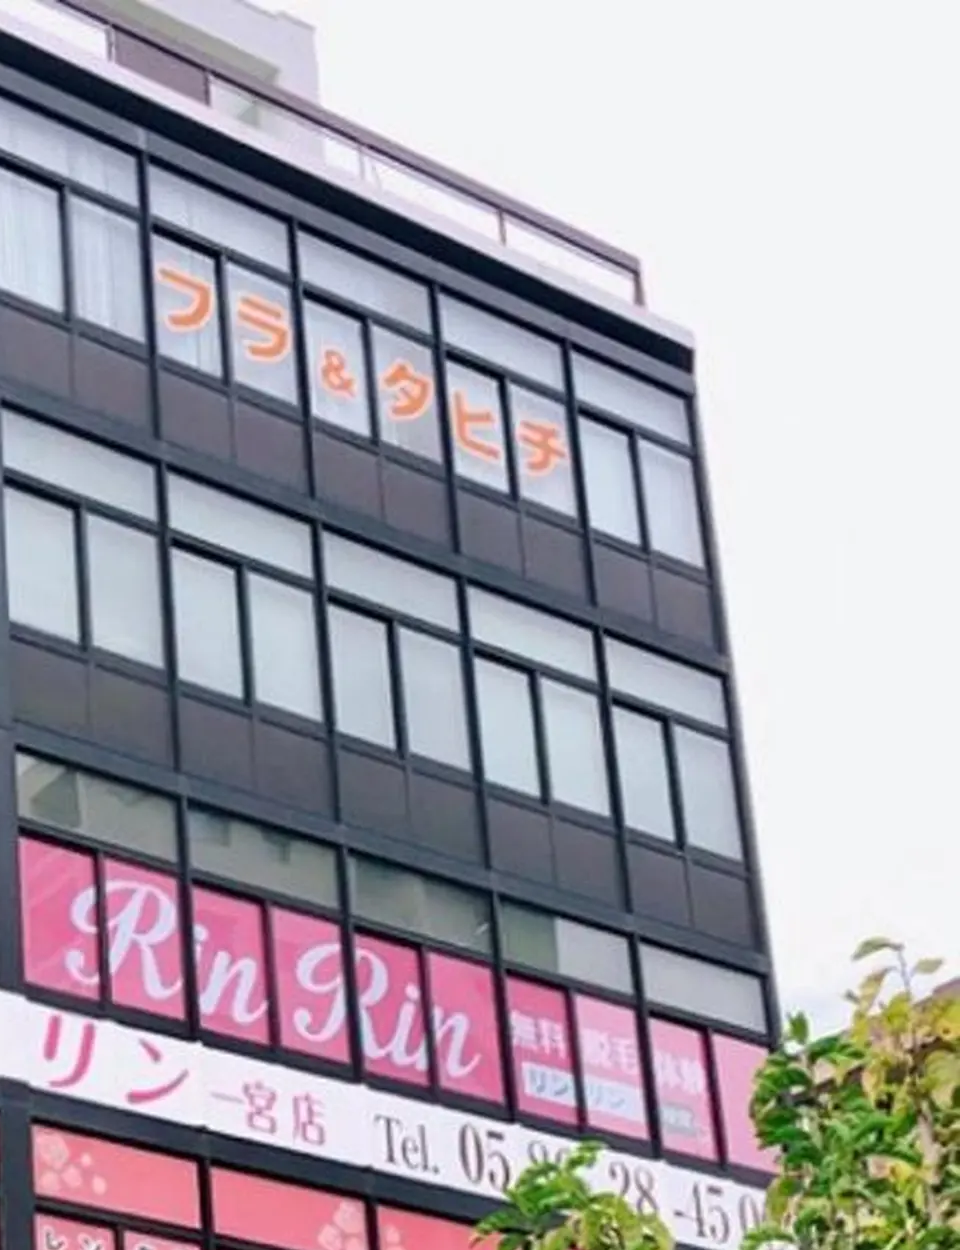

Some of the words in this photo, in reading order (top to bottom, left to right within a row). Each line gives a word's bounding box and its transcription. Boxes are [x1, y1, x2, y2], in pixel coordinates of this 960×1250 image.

[64, 879, 270, 1025] Rin
[292, 940, 482, 1078] Rin
[374, 1113, 440, 1176] Tel.
